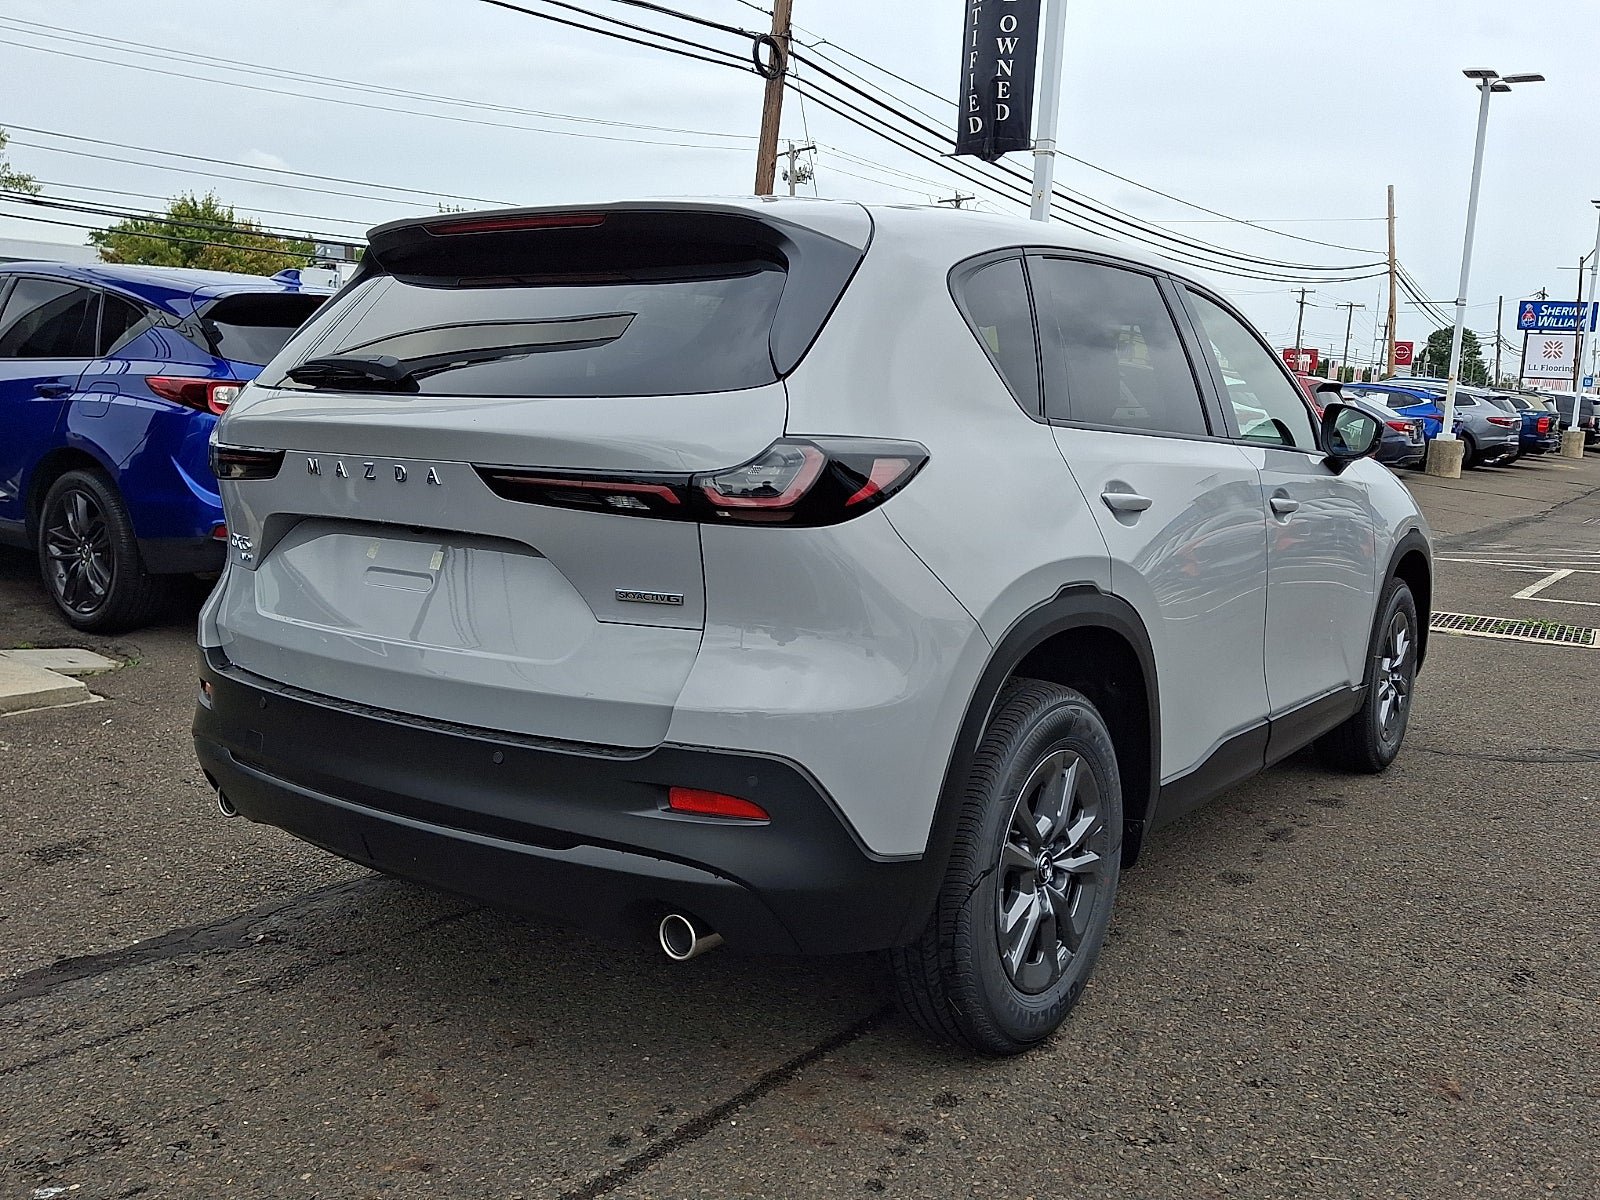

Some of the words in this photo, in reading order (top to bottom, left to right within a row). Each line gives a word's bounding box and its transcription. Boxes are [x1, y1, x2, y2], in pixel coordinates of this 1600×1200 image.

[968, 0, 983, 135] TIFIED
[1537, 315, 1588, 328] WILLIAM
[1540, 364, 1574, 374] Flooring
[307, 457, 442, 485] MAZDA
